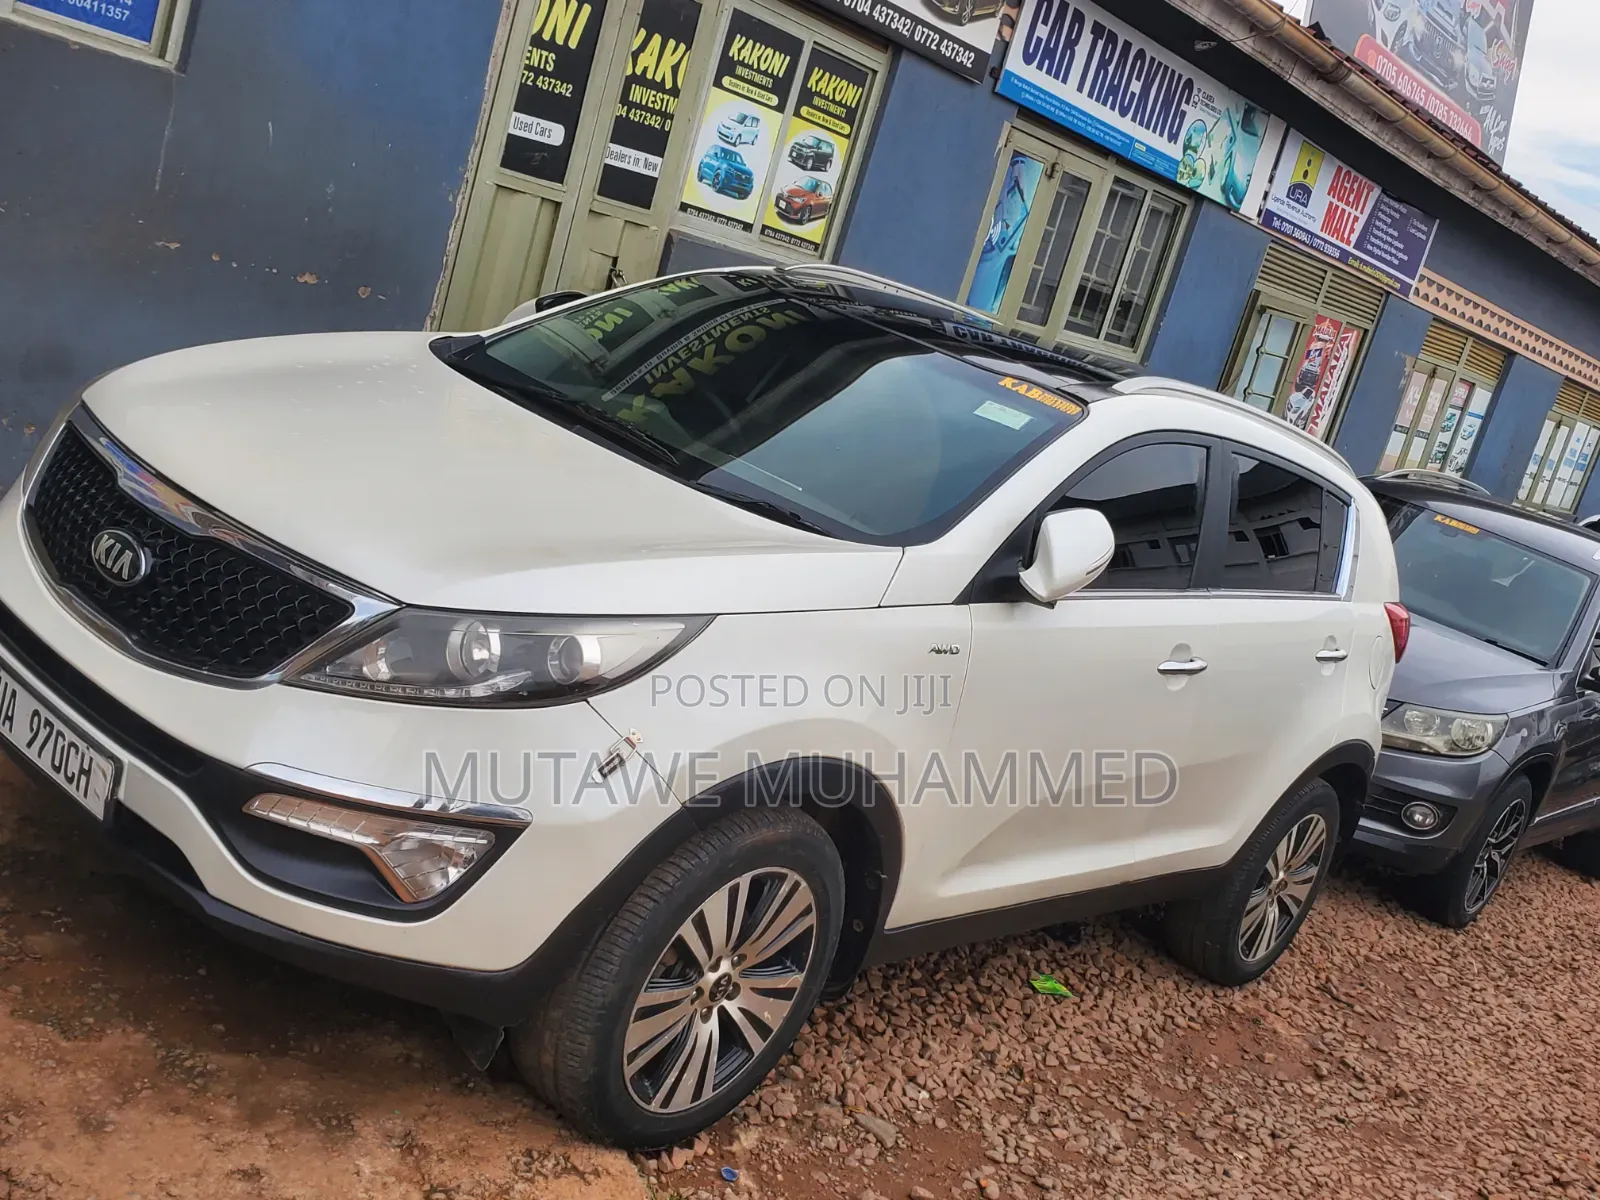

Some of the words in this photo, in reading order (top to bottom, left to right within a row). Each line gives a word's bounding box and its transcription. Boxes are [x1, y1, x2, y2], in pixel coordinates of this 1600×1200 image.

[729, 33, 791, 78] KAKONI
[914, 25, 940, 50] 0772
[940, 39, 975, 68] 437342
[735, 65, 774, 88] INVESTMENTS
[1022, 0, 1086, 85] CAR
[1076, 19, 1194, 146] TRACKING
[1376, 55, 1398, 85] 0705
[536, 75, 574, 97] 437342
[807, 66, 863, 108] KAKONI
[813, 95, 847, 118] INVESTMENTS
[512, 117, 532, 134] Used
[534, 124, 553, 139] Cars
[643, 157, 659, 173] New
[1289, 186, 1308, 205] URA
[1327, 165, 1375, 215] AGENT
[1271, 194, 1286, 207] Uganda
[1286, 200, 1301, 214] Revenue
[1301, 208, 1318, 223] Authority
[1281, 221, 1293, 235] 0701
[1320, 200, 1360, 247] MALE
[95, 533, 134, 580] KIA
[927, 643, 961, 655] AWD
